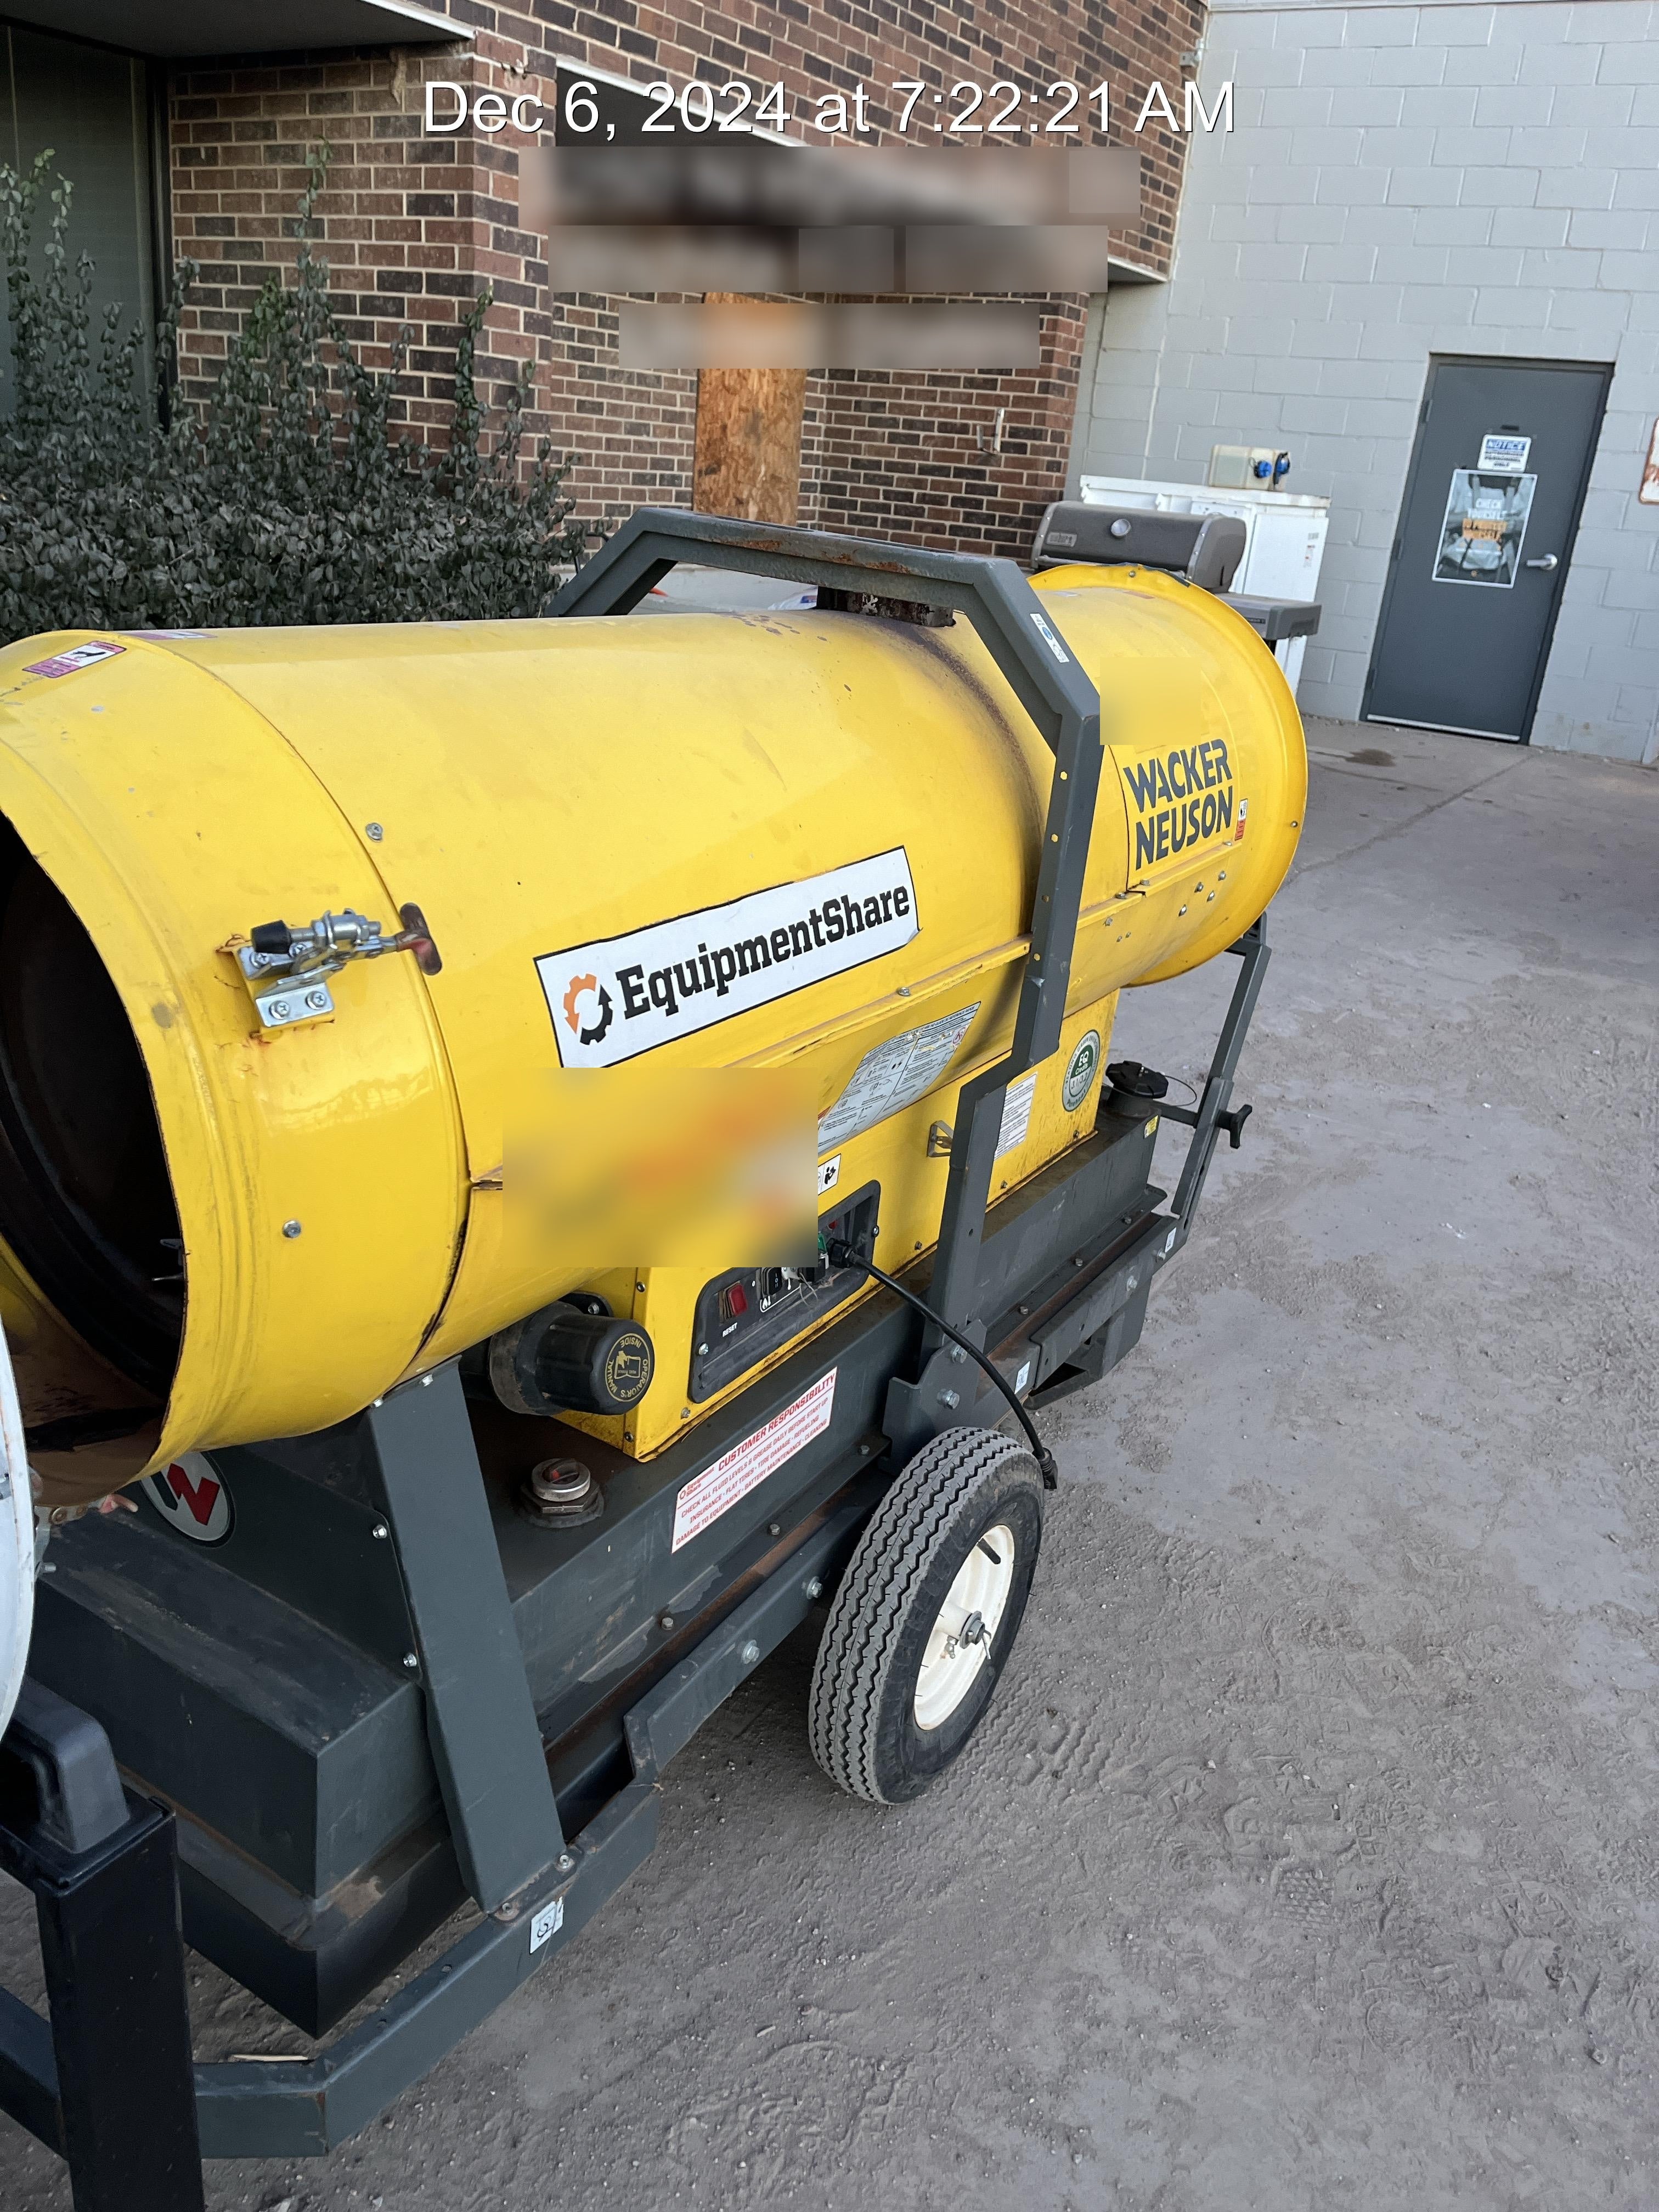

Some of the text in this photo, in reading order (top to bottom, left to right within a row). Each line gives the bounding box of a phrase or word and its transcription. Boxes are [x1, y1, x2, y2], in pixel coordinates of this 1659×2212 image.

[1122, 738, 1233, 814] WACKER
[1135, 785, 1233, 871] NEUSON
[615, 885, 910, 1020] EquipmentShare
[1078, 1050, 1089, 1067] EQ
[620, 1336, 642, 1349] INSIDE
[722, 1322, 738, 1338] RESET
[607, 1358, 648, 1398] OPERATOR'S MANUAL
[681, 1498, 701, 1519] CHECK
[701, 1489, 711, 1503] ALL
[712, 1476, 728, 1494] FLUID
[729, 1461, 747, 1480] LEVELS
[753, 1441, 772, 1462] GREASE
[773, 1429, 787, 1446] DAILY
[788, 1414, 805, 1434] BEFORE
[806, 1402, 821, 1419] START
[821, 1396, 828, 1407] UP
[718, 1373, 834, 1471] CUSTOMER RESPONSIBILITY
[676, 1418, 827, 1546] DAMAGE TO EQUIPMENT BATTERY MAINTENANCE CLEANING
[690, 1414, 819, 1523] INSURANCE FLAT TIRES TIRE DAMAGE REFUELING
